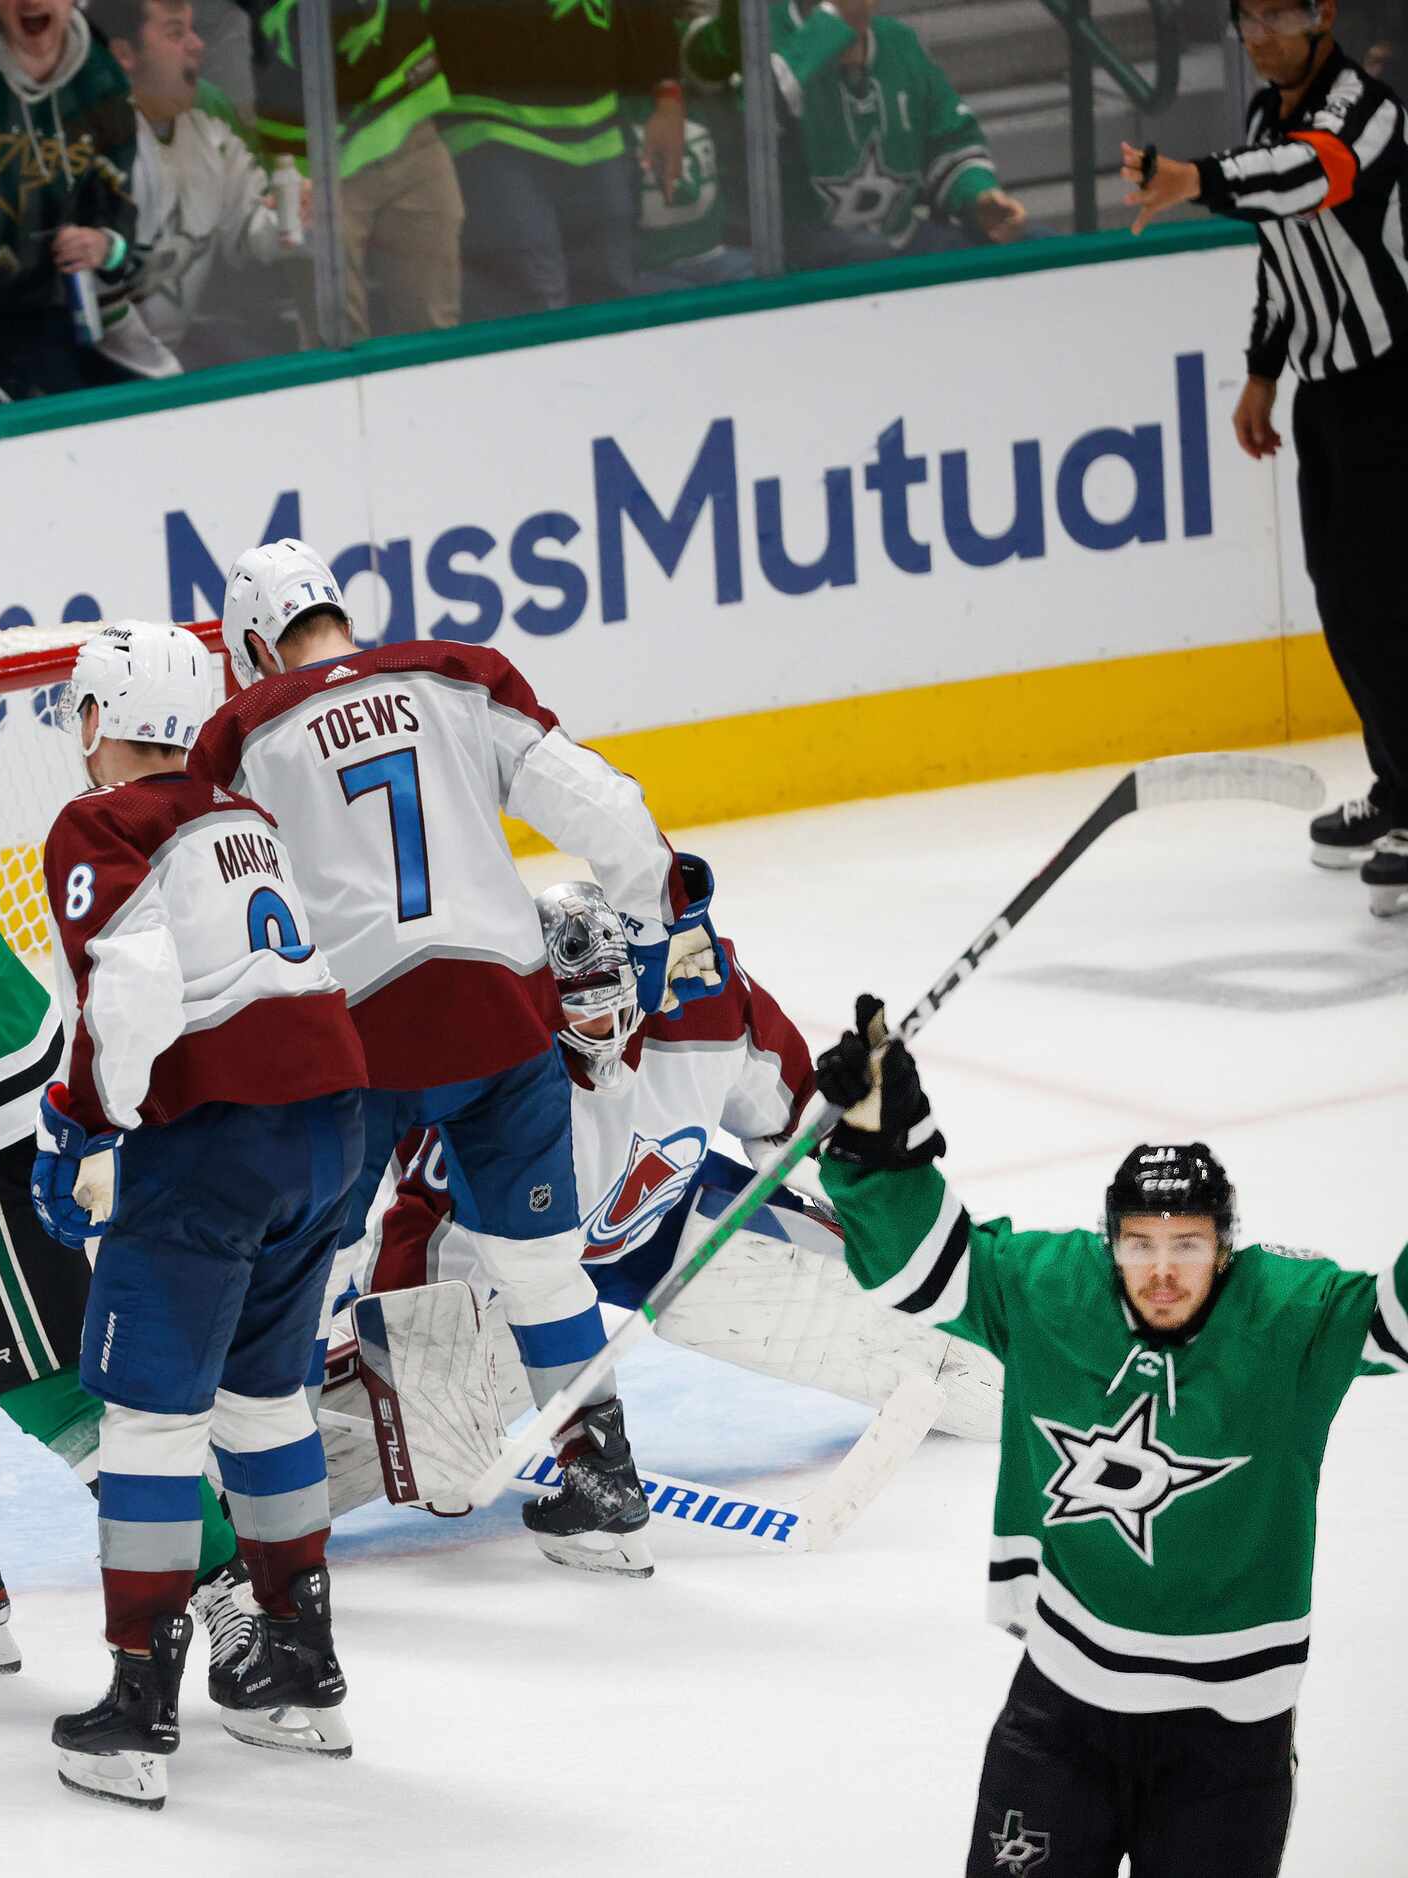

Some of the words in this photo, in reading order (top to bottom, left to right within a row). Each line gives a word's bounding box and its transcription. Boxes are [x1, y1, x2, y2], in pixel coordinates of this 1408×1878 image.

[165, 351, 1214, 646] MassMutual
[164, 715, 178, 738] 8
[307, 694, 419, 760] TOEWS
[214, 832, 284, 884] MAKAR
[337, 746, 432, 923] 7
[65, 862, 96, 921] 8
[100, 1311, 118, 1375] BAUER
[379, 1397, 409, 1500] TRUE
[515, 1454, 800, 1543] WRIOR
[246, 1676, 272, 1694] BAUER
[318, 1675, 343, 1689] BAUE
